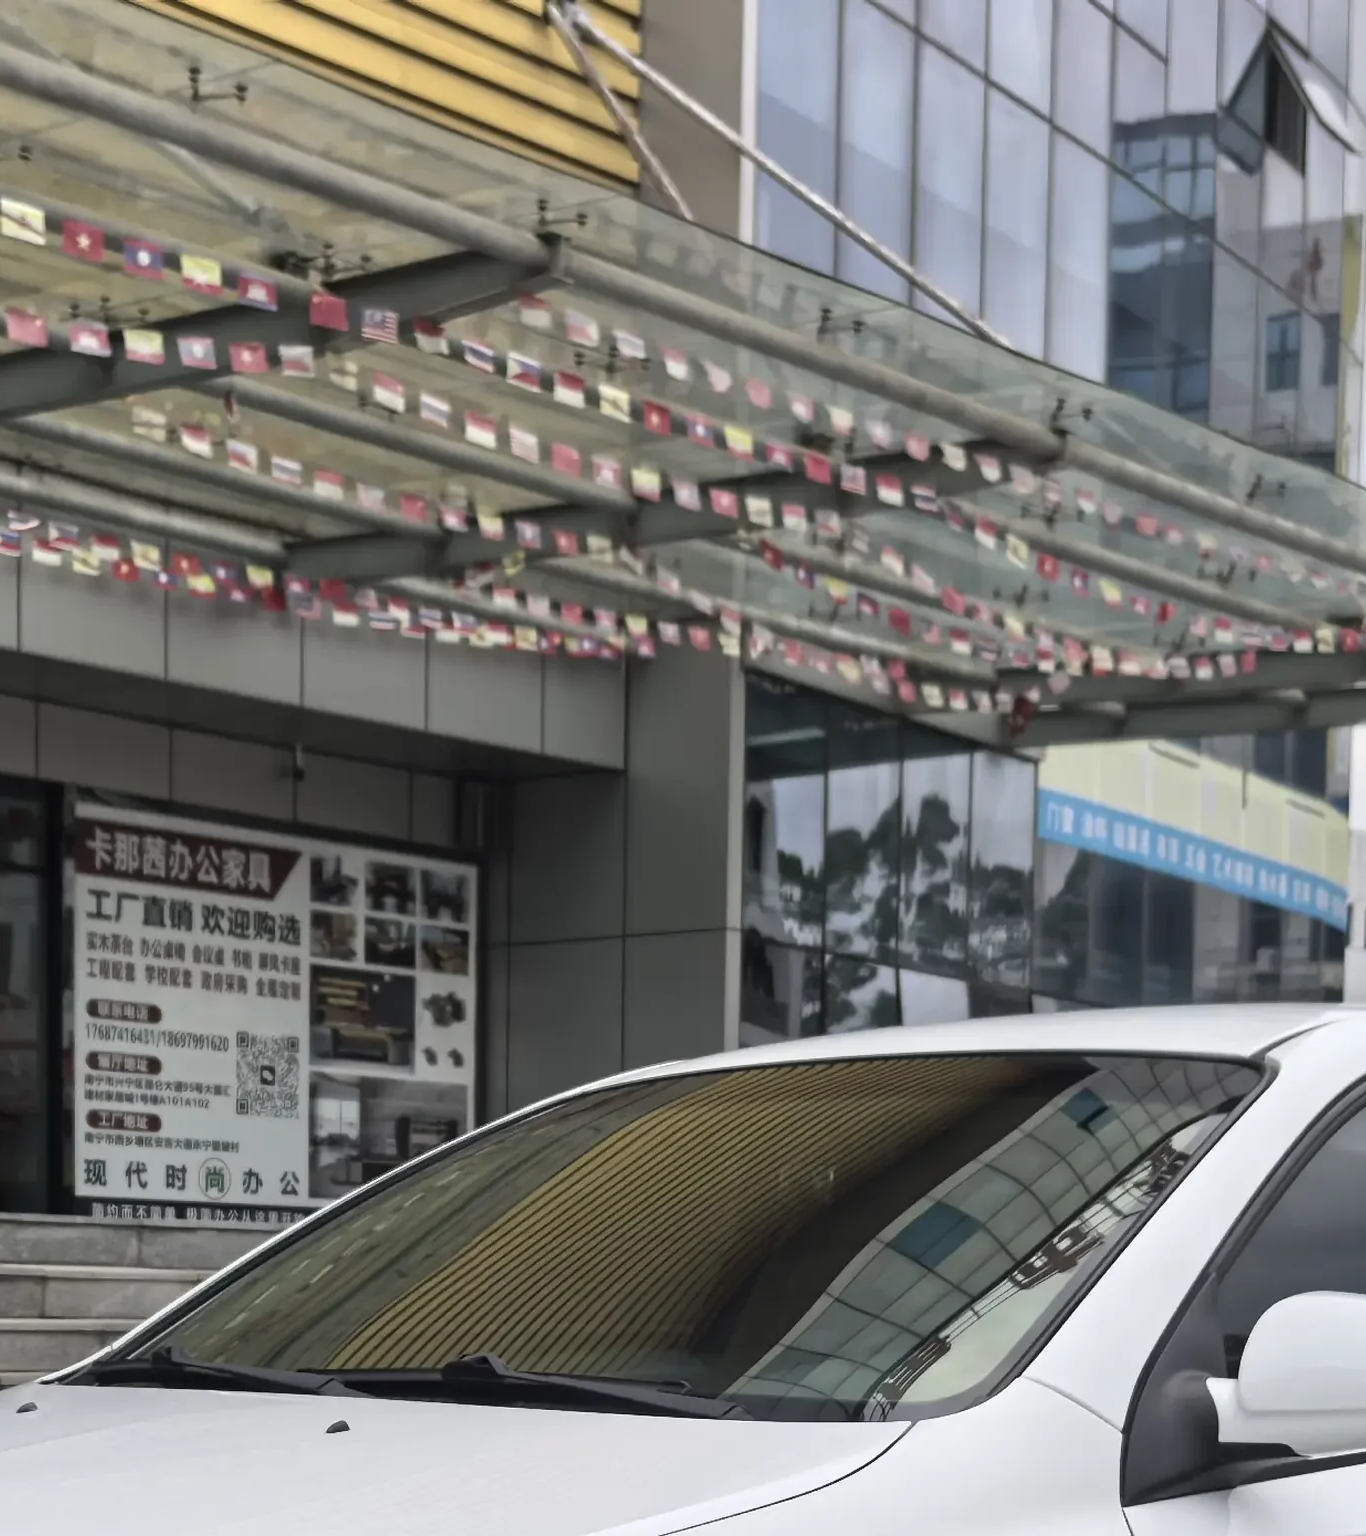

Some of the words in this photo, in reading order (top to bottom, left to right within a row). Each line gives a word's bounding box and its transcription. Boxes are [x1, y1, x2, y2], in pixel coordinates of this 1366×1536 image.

[86, 888, 194, 932] 工厂直销
[201, 903, 302, 946] 欢迎购选
[84, 1158, 301, 1196] 现代时尚办公
